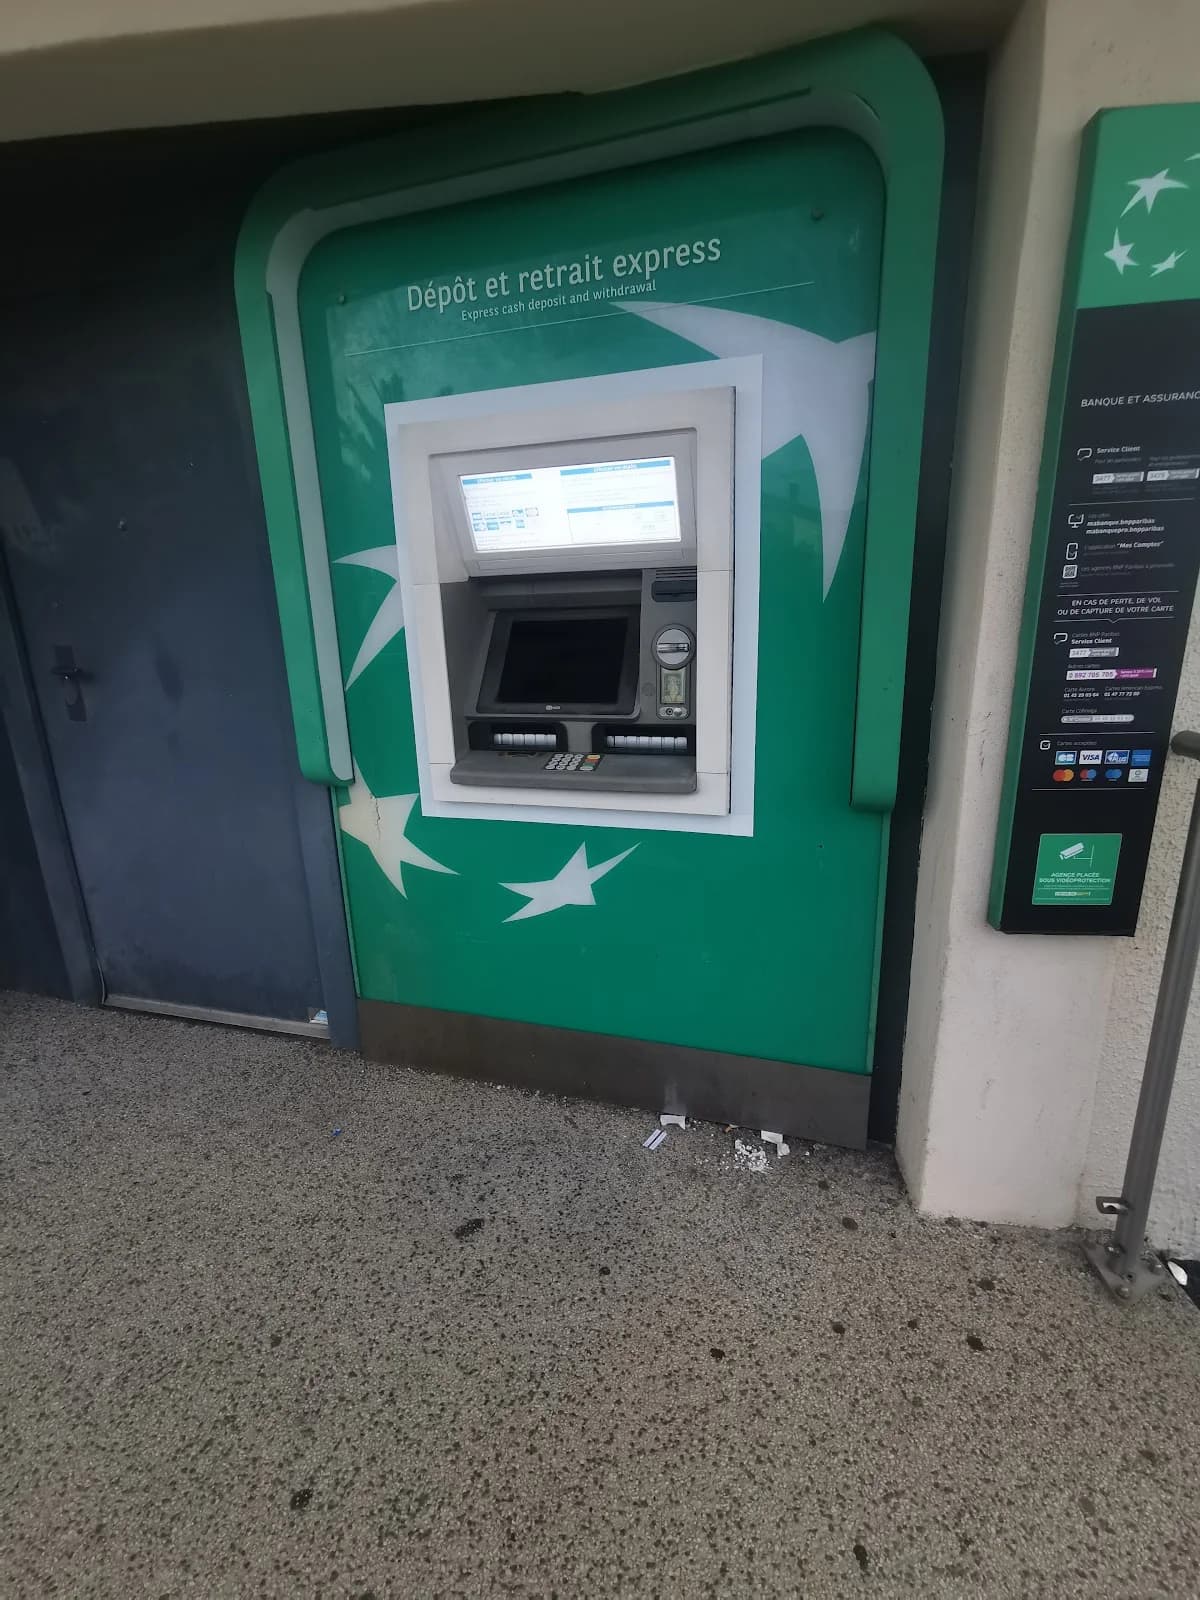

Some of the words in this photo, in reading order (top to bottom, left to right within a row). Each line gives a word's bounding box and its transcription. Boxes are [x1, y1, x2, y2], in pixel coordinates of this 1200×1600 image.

[407, 276, 478, 314] Dépôt
[486, 271, 510, 299] et
[519, 254, 604, 294] retrait
[613, 237, 722, 281] express
[461, 306, 500, 323] Express
[502, 301, 526, 315] cash
[528, 294, 567, 314] deposit
[570, 290, 590, 304] and
[592, 279, 657, 301] withdrawal
[1081, 396, 1125, 408] BANQUE
[1127, 395, 1141, 405] ET
[1096, 446, 1120, 454] Service
[1098, 598, 1109, 606] DE
[1081, 607, 1113, 615] CAPTURE
[1115, 606, 1125, 614] DE
[1126, 605, 1149, 613] VOTRE
[1151, 604, 1175, 612] CARTE
